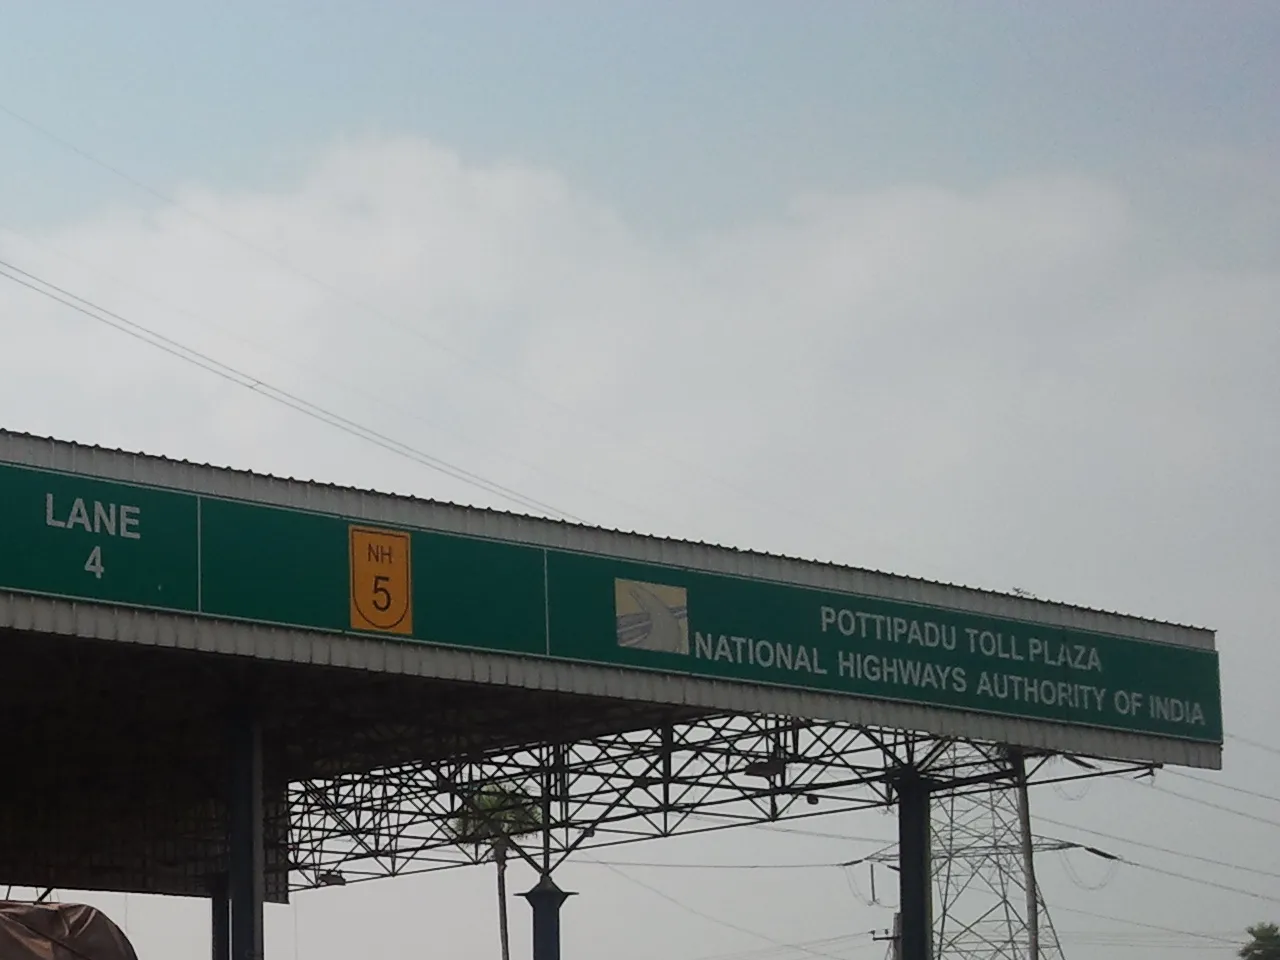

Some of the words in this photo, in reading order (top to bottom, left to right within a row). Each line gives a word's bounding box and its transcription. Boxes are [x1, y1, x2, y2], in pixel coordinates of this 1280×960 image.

[46, 493, 141, 540] LANE
[84, 545, 105, 579] 4
[367, 543, 393, 565] NH
[371, 576, 391, 612] 5
[820, 606, 957, 650] POTTIPADU
[965, 628, 1024, 661] TOLL
[1029, 638, 1102, 672] PLAZA
[695, 632, 827, 675] NATIONAL
[839, 651, 967, 692] HIGHWAYS
[976, 671, 1106, 712] AUTHORITY
[1114, 690, 1143, 716] OF
[1149, 695, 1206, 726] INDIA
